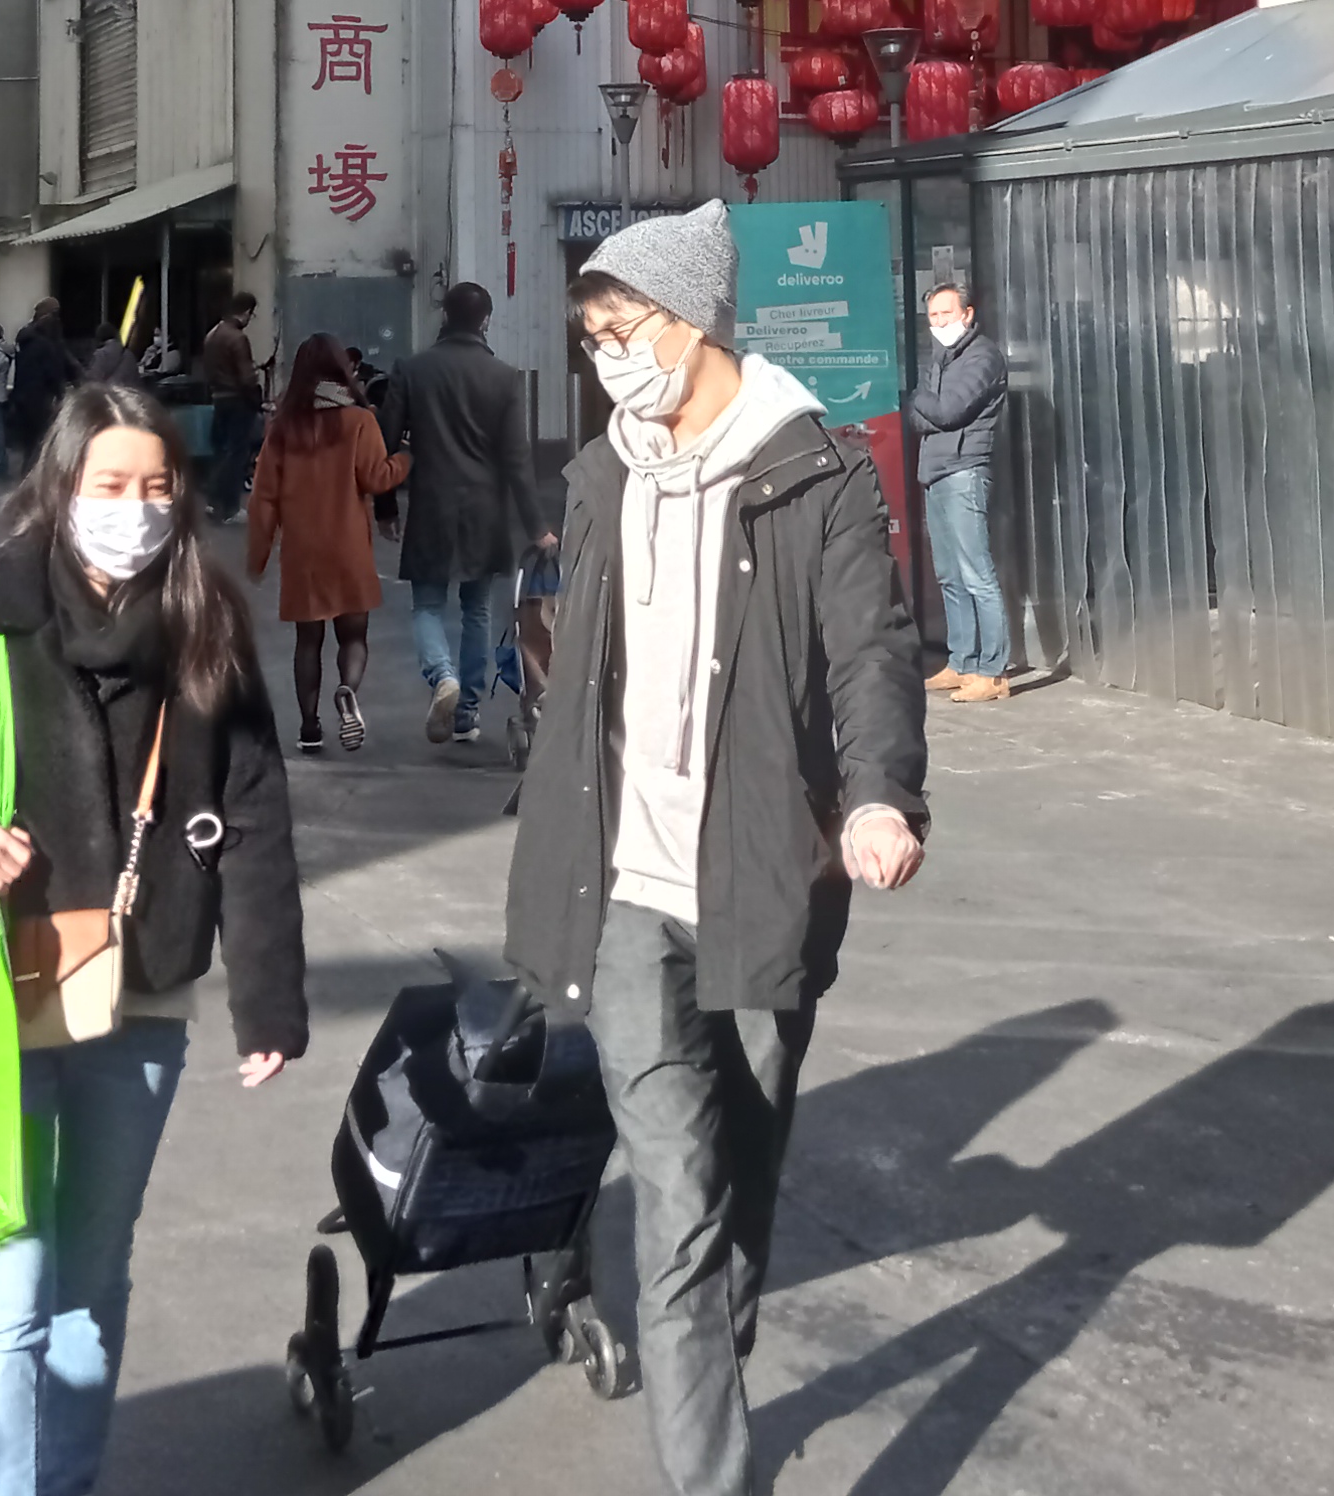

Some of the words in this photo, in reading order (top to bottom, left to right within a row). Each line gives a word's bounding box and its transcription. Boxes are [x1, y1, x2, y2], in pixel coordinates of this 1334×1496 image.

[777, 273, 844, 287] deliveroo
[769, 309, 796, 320] Cher
[799, 306, 836, 317] livreur
[746, 326, 808, 336] Deliveroo
[765, 338, 825, 351] Récupérez
[808, 353, 879, 365] commande
